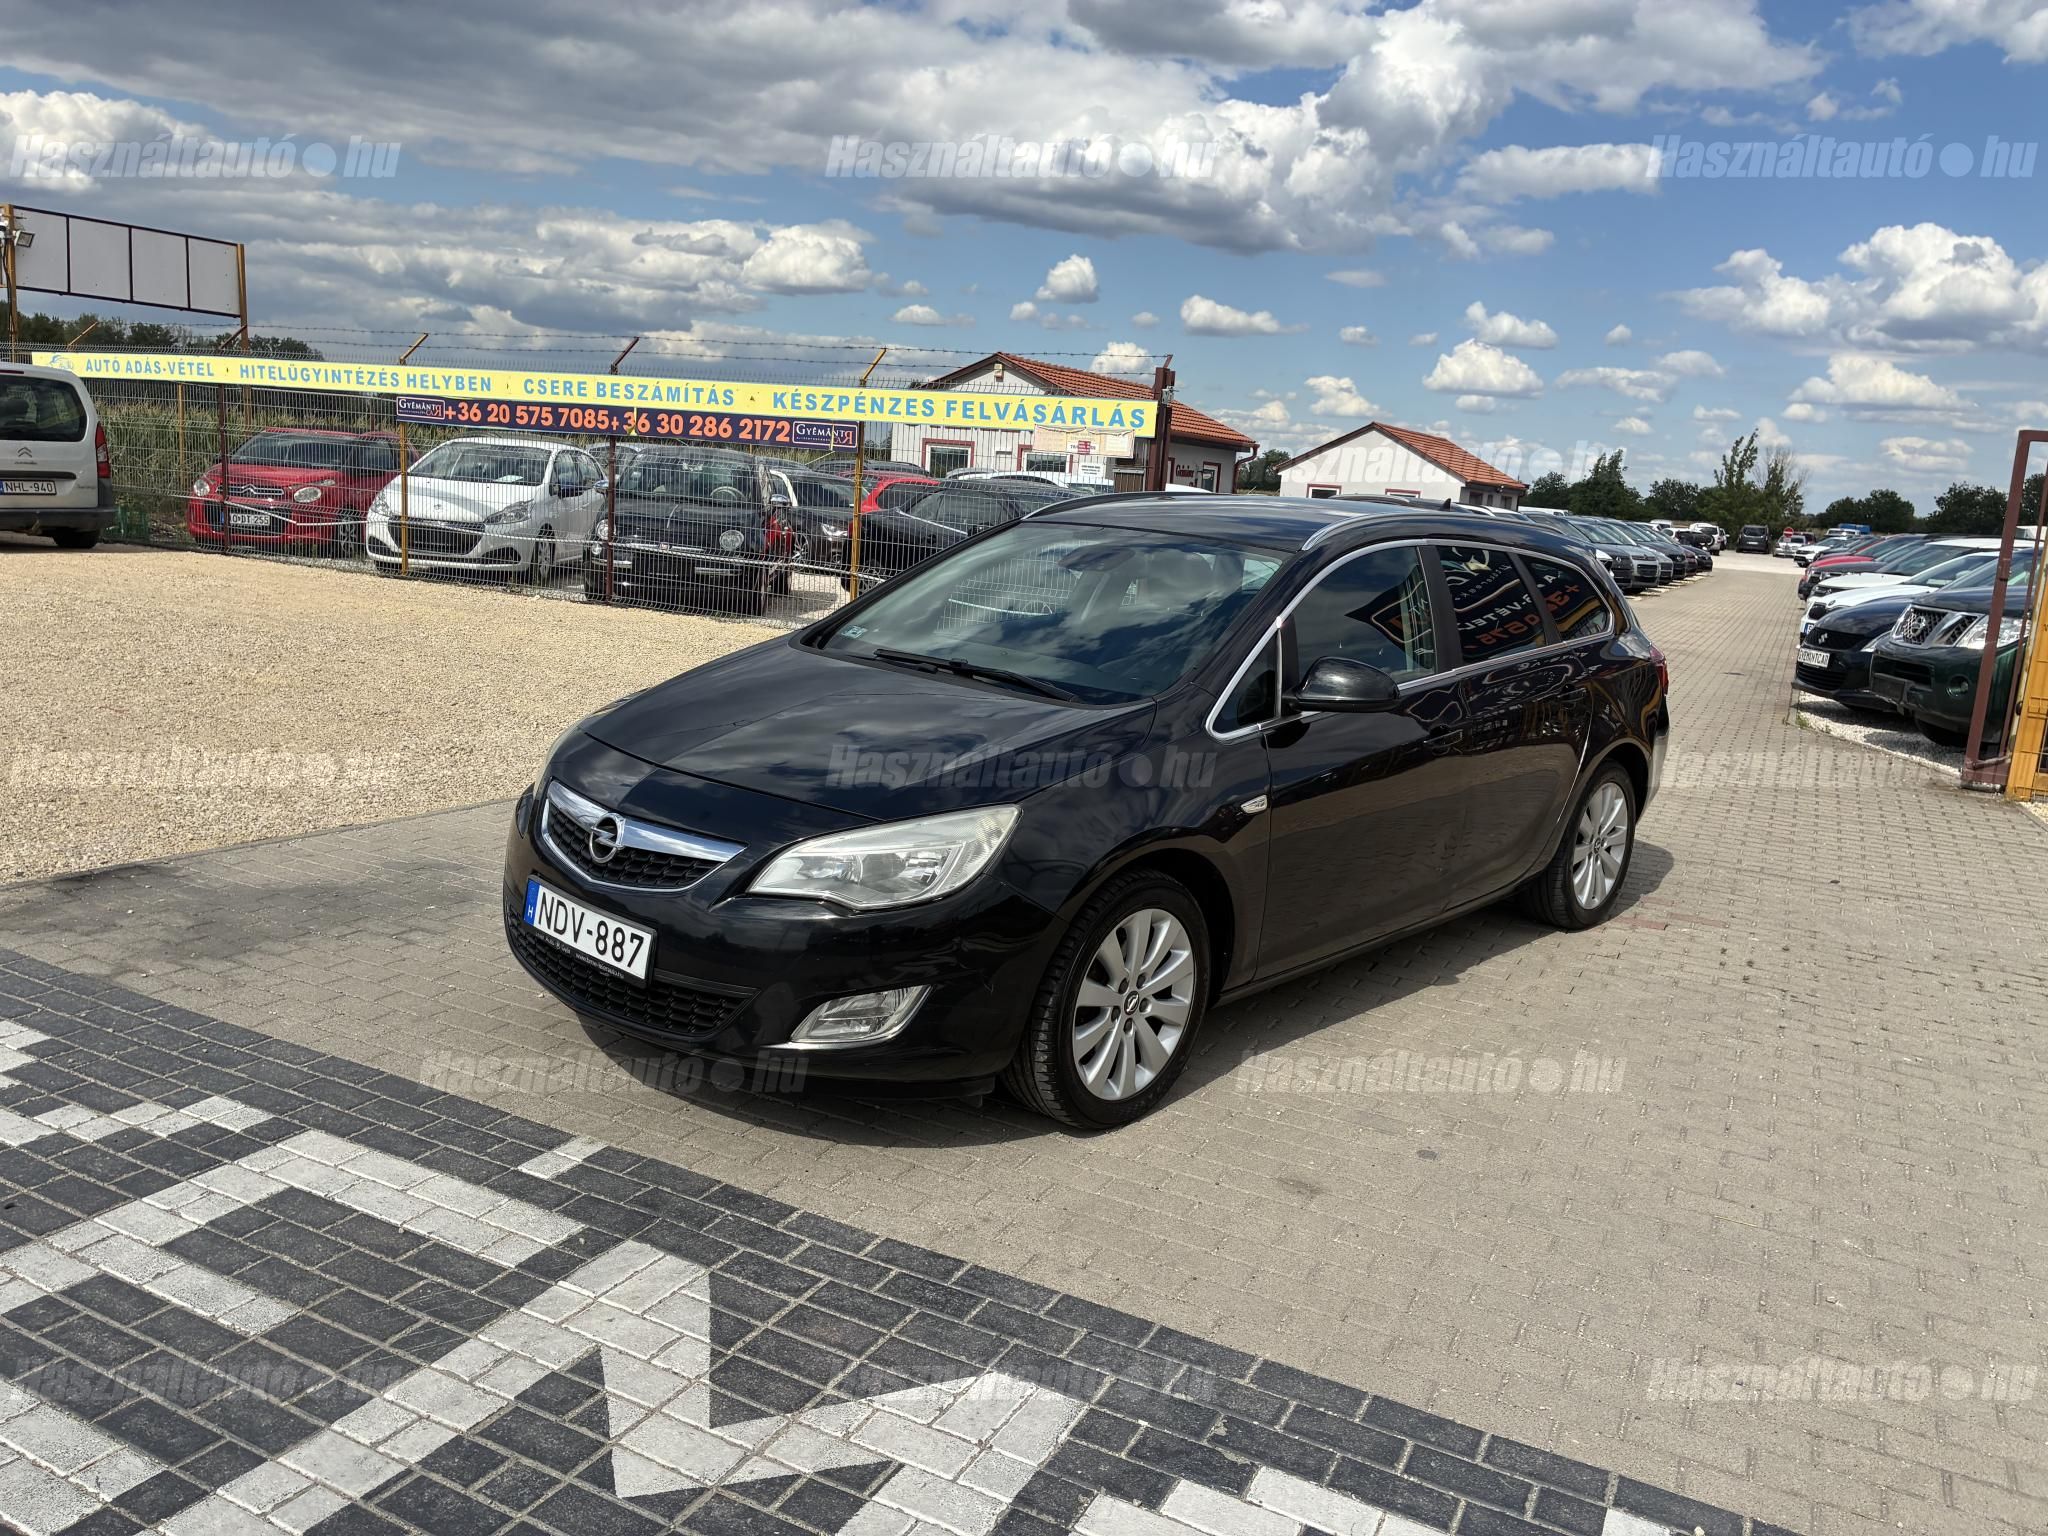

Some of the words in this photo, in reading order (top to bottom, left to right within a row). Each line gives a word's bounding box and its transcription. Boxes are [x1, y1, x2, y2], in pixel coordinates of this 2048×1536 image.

[86, 356, 120, 373] AUTÓ
[125, 356, 214, 377] ADÁS-VÉTEL
[240, 363, 400, 387] HITELÜGYINTÉZÉS
[406, 373, 492, 392] HELYBEN
[523, 378, 588, 397] CSERE
[596, 381, 735, 406] BESZÁMÍTÁS
[772, 387, 935, 417] KÉSZPÉNZES
[945, 397, 1146, 429] FELVÁSÁRLÁS
[444, 402, 482, 422] +36
[487, 403, 511, 424] 20
[516, 406, 553, 426] 575
[656, 413, 684, 435] 30
[689, 415, 733, 438] 286
[738, 418, 790, 442] 2172
[4, 482, 53, 492] NHL-940
[538, 891, 645, 968] NDV-887
